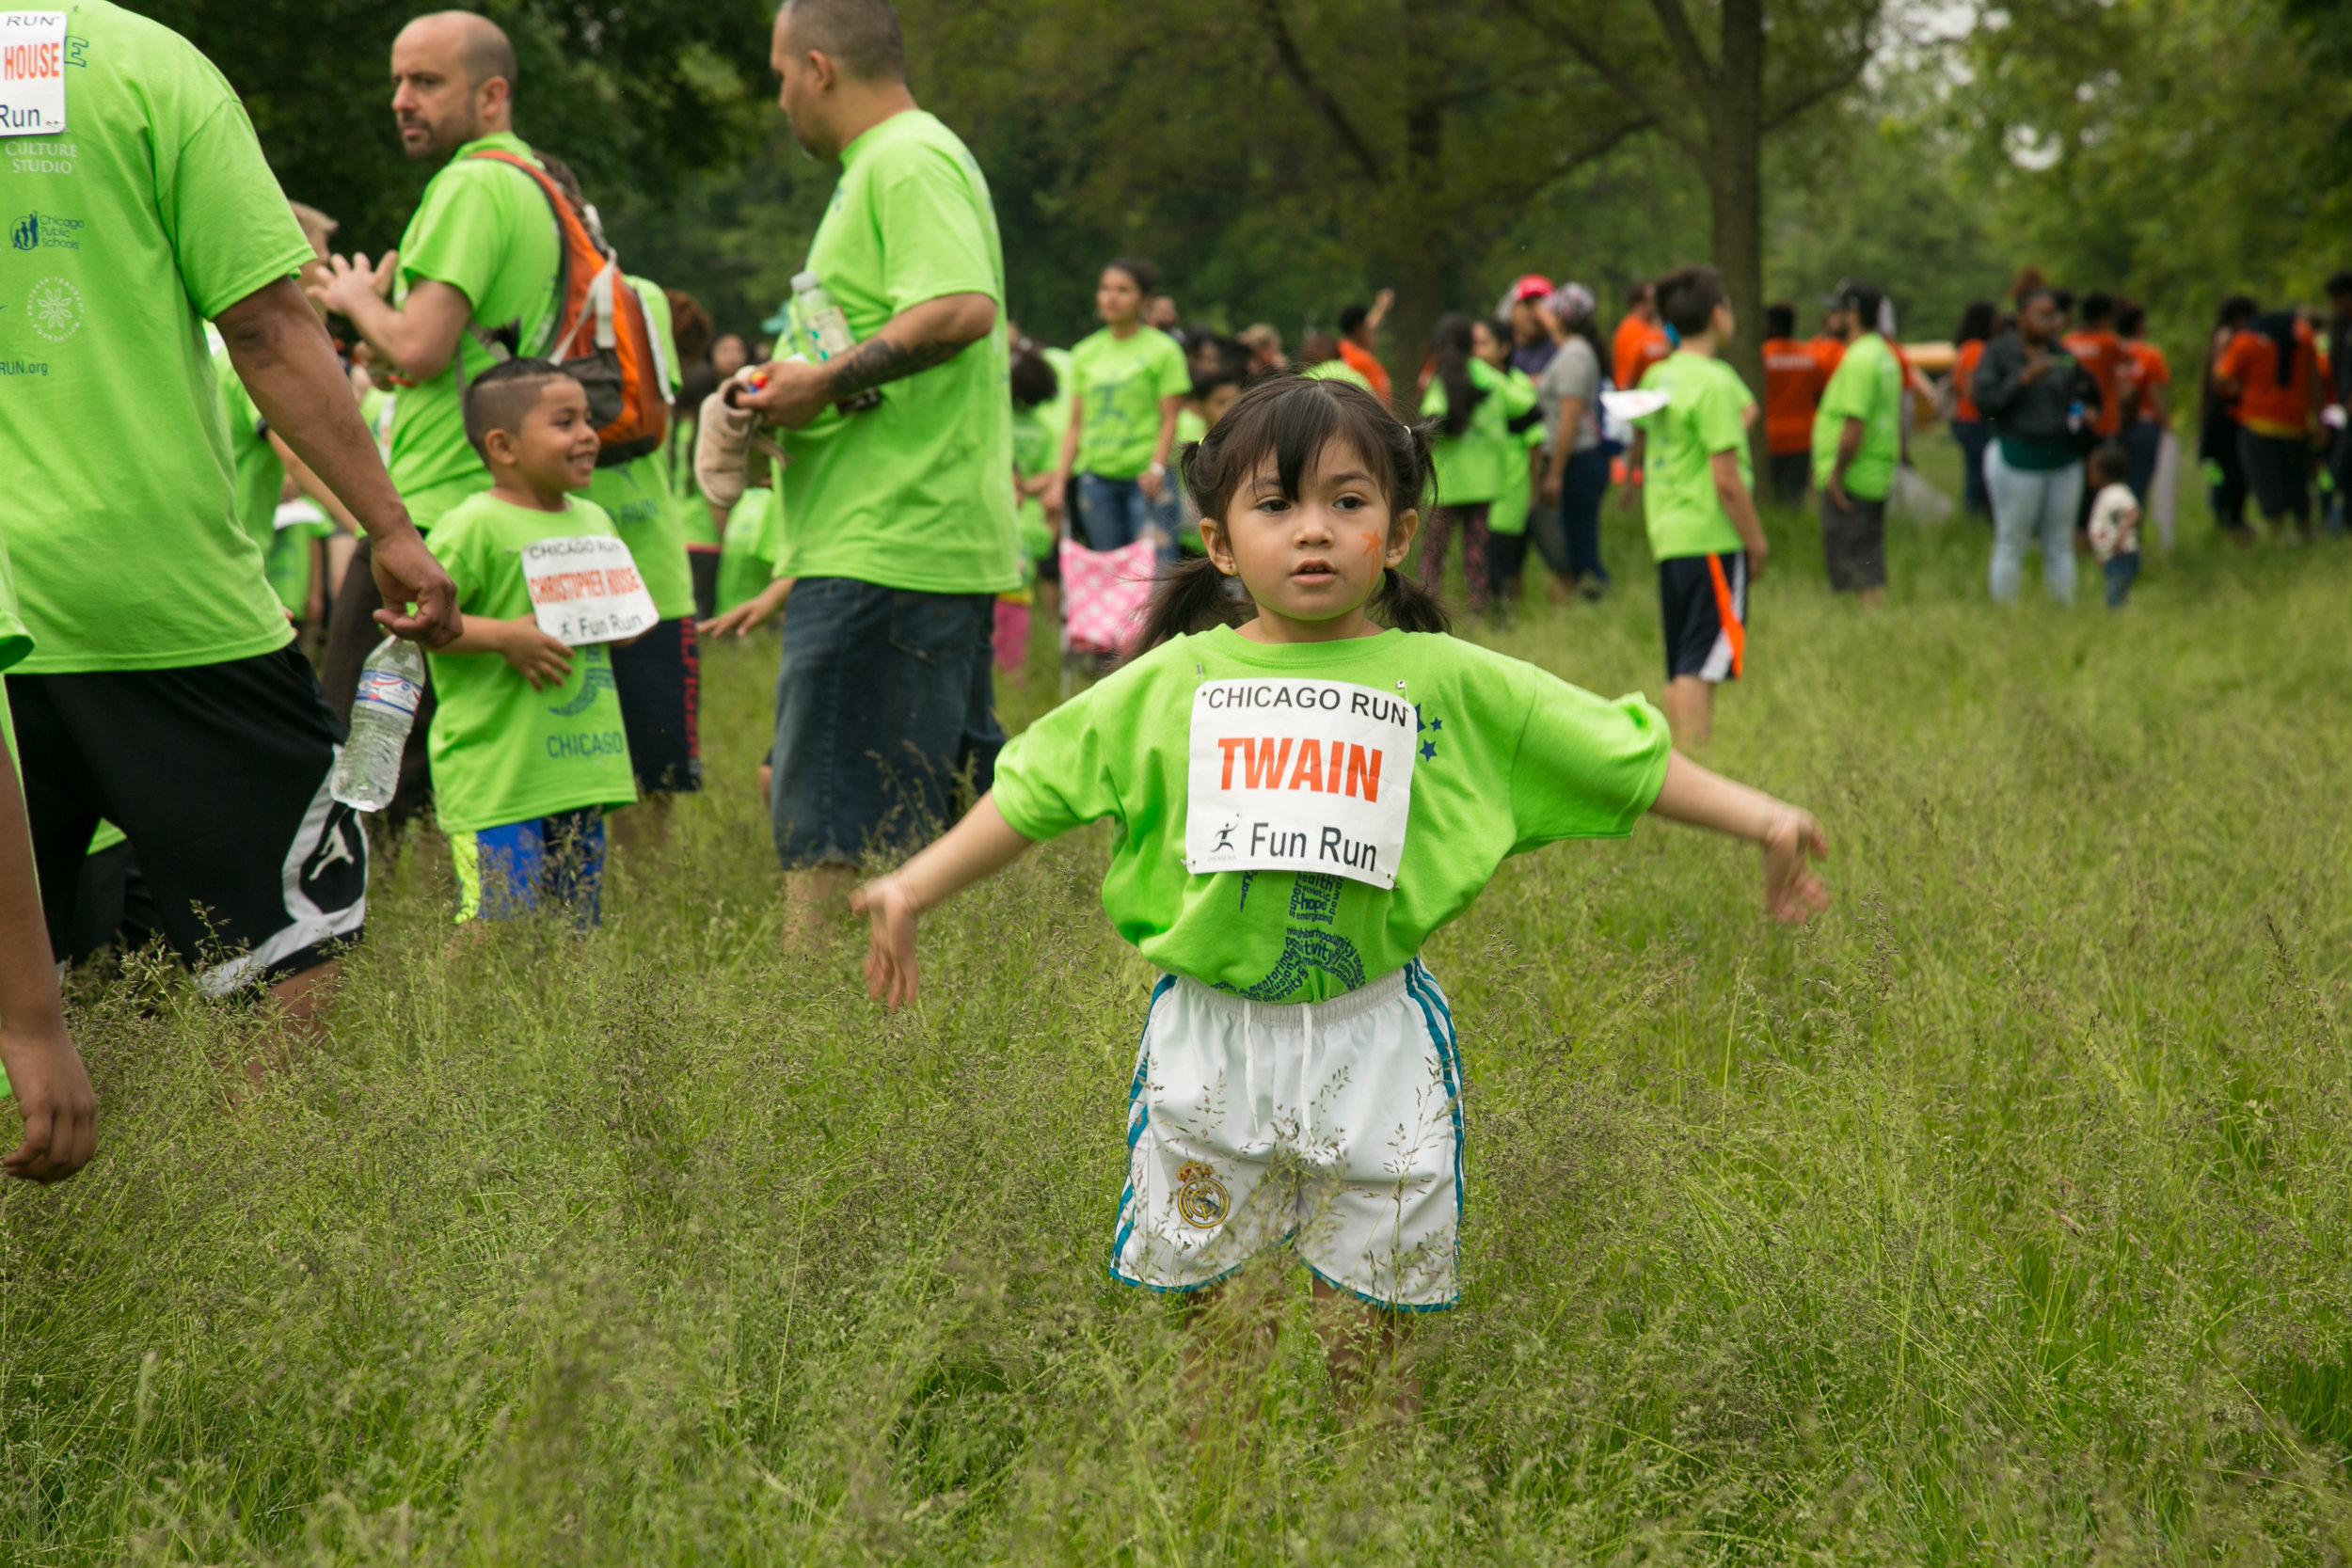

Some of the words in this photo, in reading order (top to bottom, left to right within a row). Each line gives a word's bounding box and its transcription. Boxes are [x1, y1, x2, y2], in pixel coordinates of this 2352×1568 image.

[7, 16, 56, 27] RUN
[5, 42, 60, 81] HOUSE
[0, 104, 40, 128] Run
[5, 142, 78, 157] CULTURE
[12, 159, 72, 174] STUDIO
[40, 214, 85, 230] Chicago
[40, 227, 71, 238] Public
[41, 237, 79, 249] Schools
[530, 541, 595, 560] CHICAGO
[579, 617, 609, 638] Fun
[610, 614, 643, 633] Run
[1208, 686, 1341, 710] CHICAGO
[1350, 692, 1406, 727] RUN
[547, 731, 624, 759] CHICAGO
[1217, 737, 1383, 803] TWAIN
[1250, 822, 1307, 859] Fun
[1319, 826, 1377, 872] Run
[1289, 879, 1302, 918] super
[1300, 893, 1327, 912] hope
[1296, 911, 1333, 925] energizing
[1248, 949, 1293, 992] mentoring
[1263, 974, 1303, 1002] diversity
